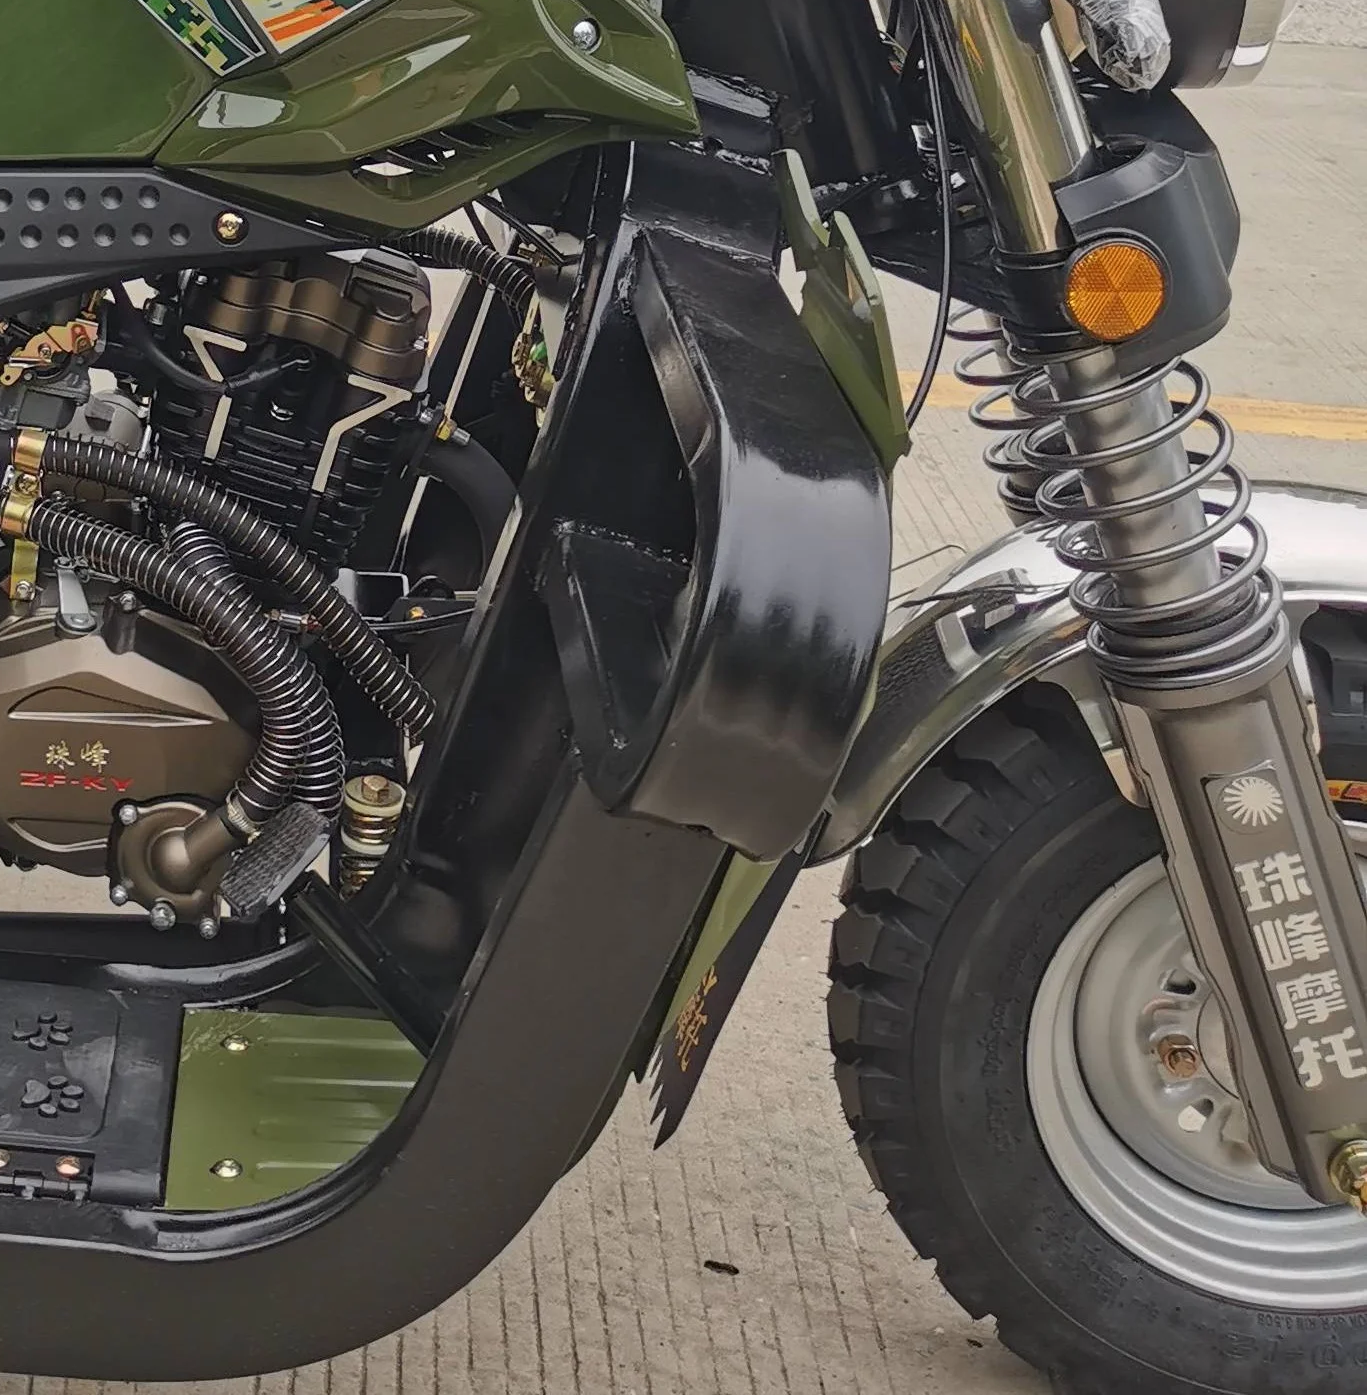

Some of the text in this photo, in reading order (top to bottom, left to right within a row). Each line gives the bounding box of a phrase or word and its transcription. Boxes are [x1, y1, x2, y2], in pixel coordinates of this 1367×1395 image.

[45, 740, 110, 773] 珠峰
[16, 770, 133, 792] ZF-KY
[1233, 852, 1367, 1088] 珠峰摩托
